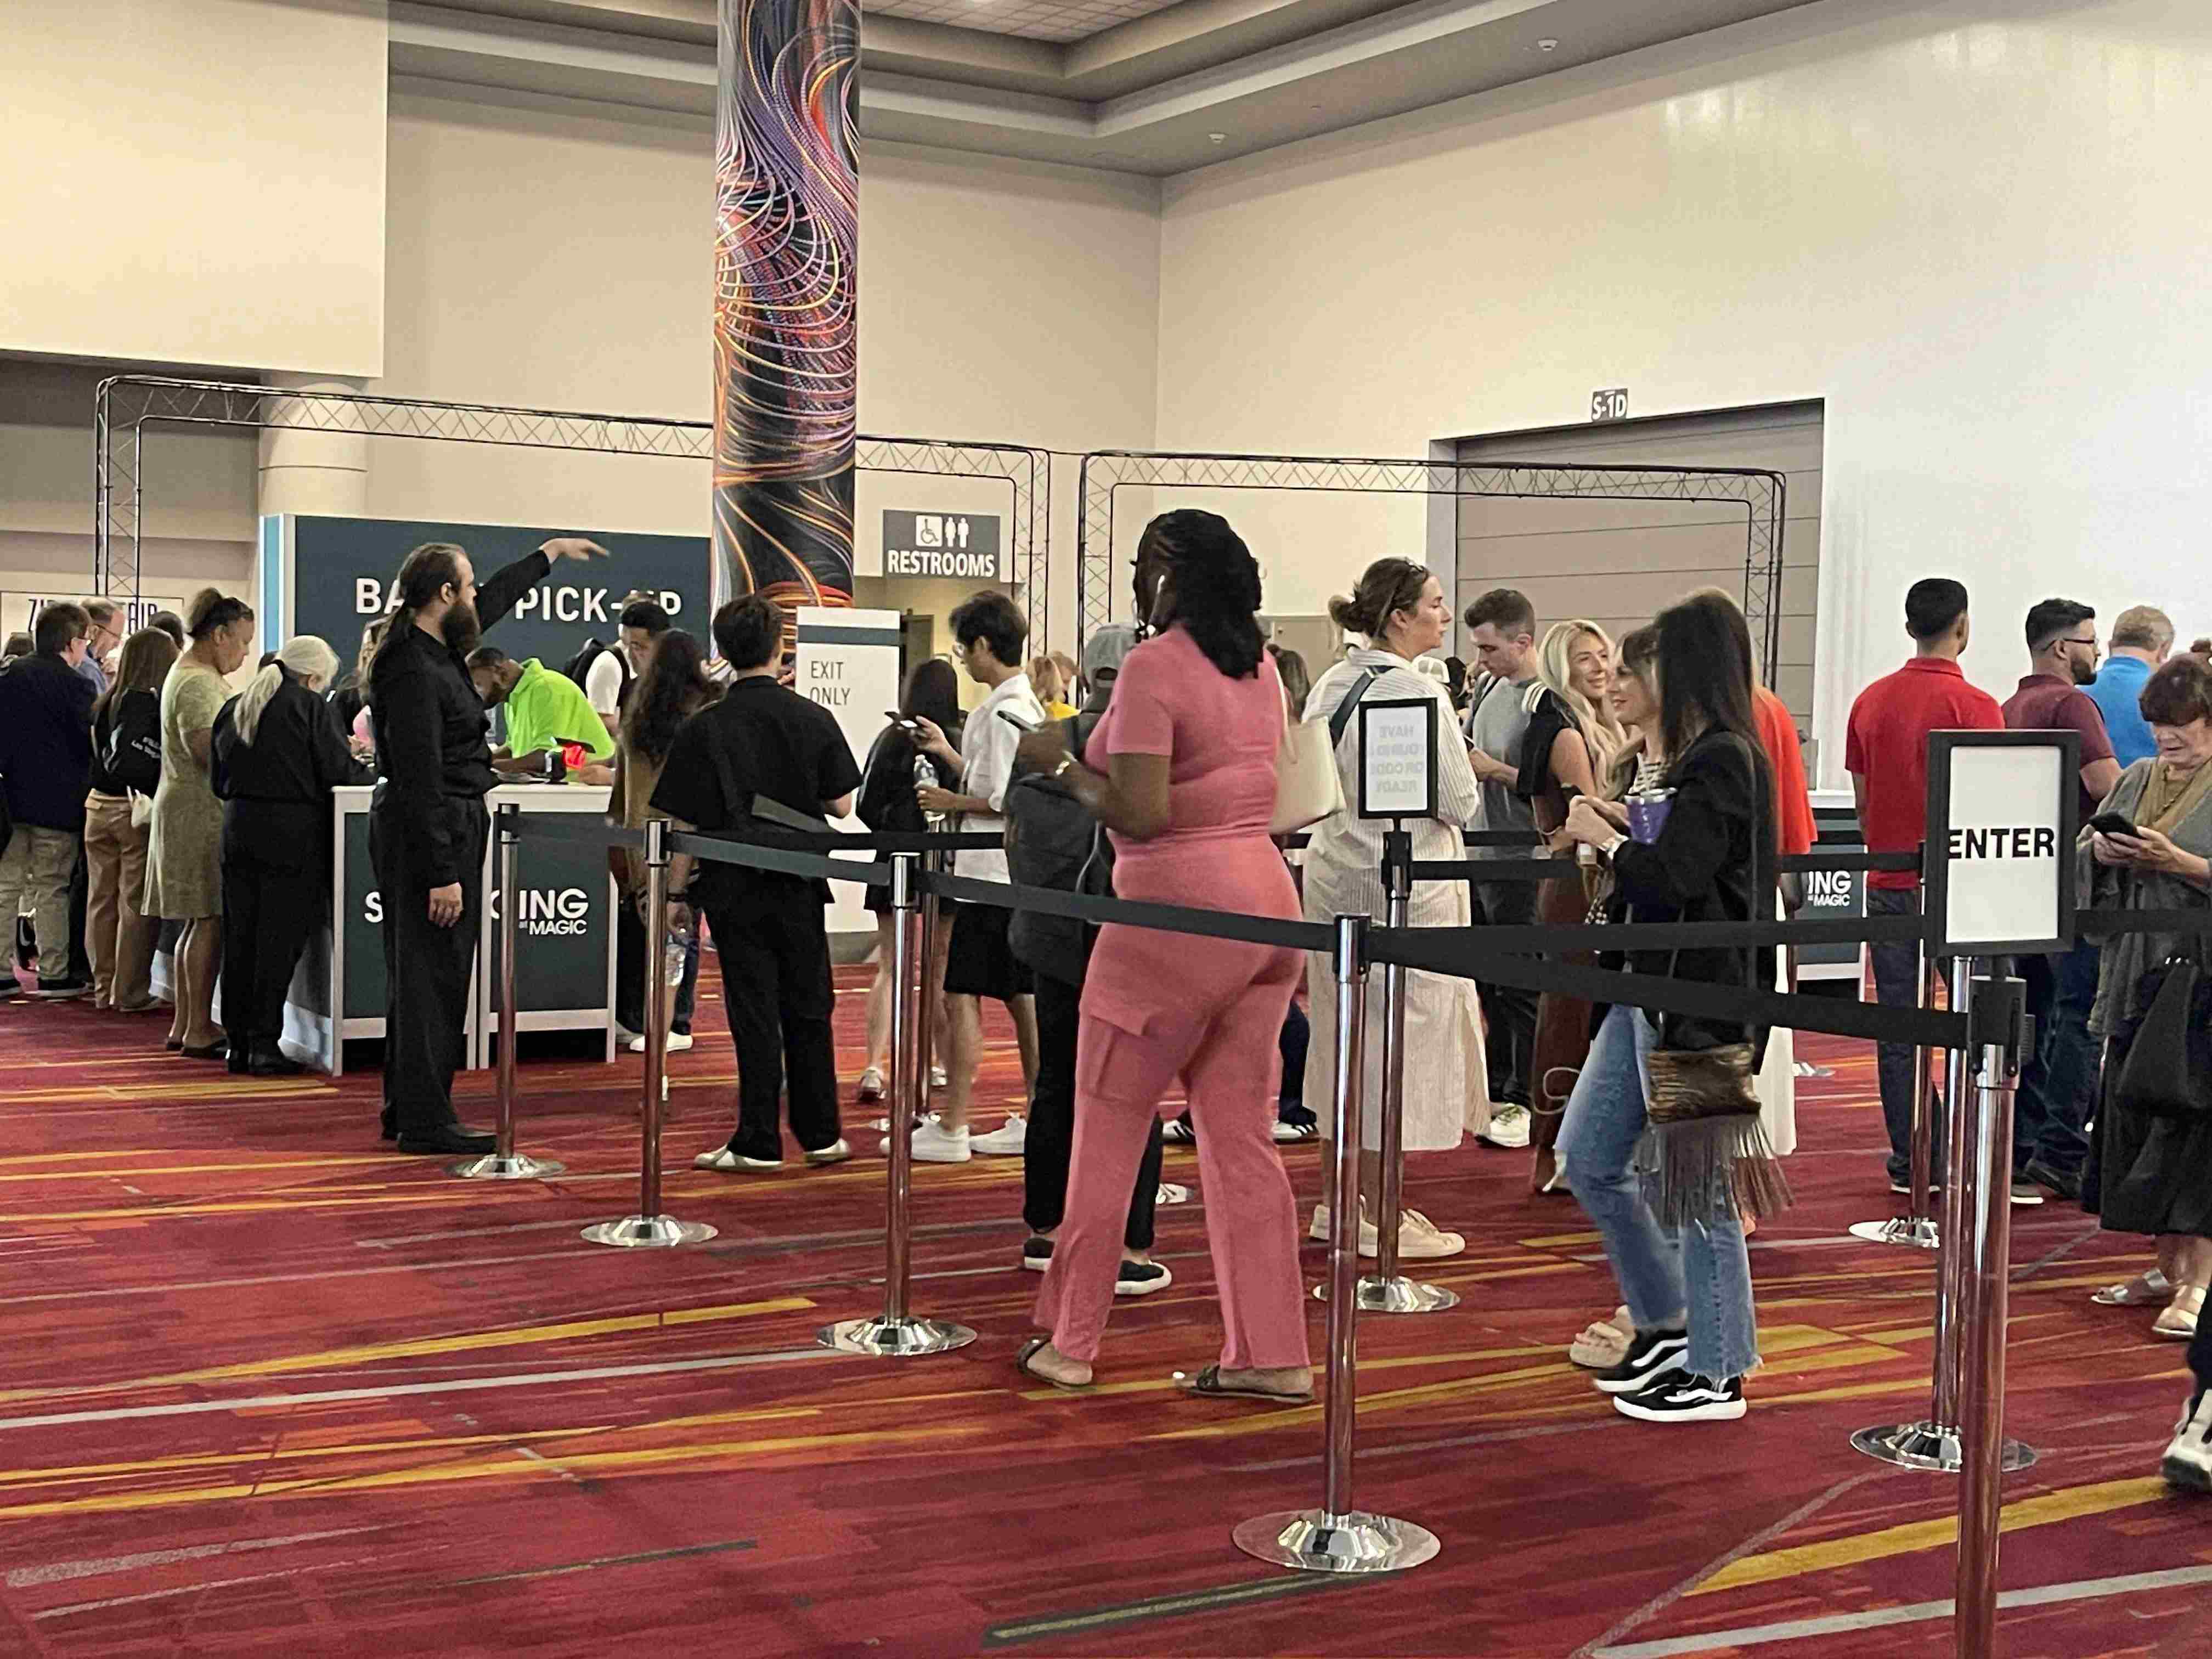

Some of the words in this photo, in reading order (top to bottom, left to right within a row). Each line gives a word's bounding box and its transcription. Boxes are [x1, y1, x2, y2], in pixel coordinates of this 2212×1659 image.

[888, 550, 995, 577] RESTROOMS
[515, 587, 682, 622] PICK-P
[811, 661, 844, 679] EXIT
[810, 687, 851, 706] ONLY
[1949, 827, 2055, 859] ENTER
[1814, 894, 1850, 906] MAGIC
[529, 919, 587, 935] MAGIC
